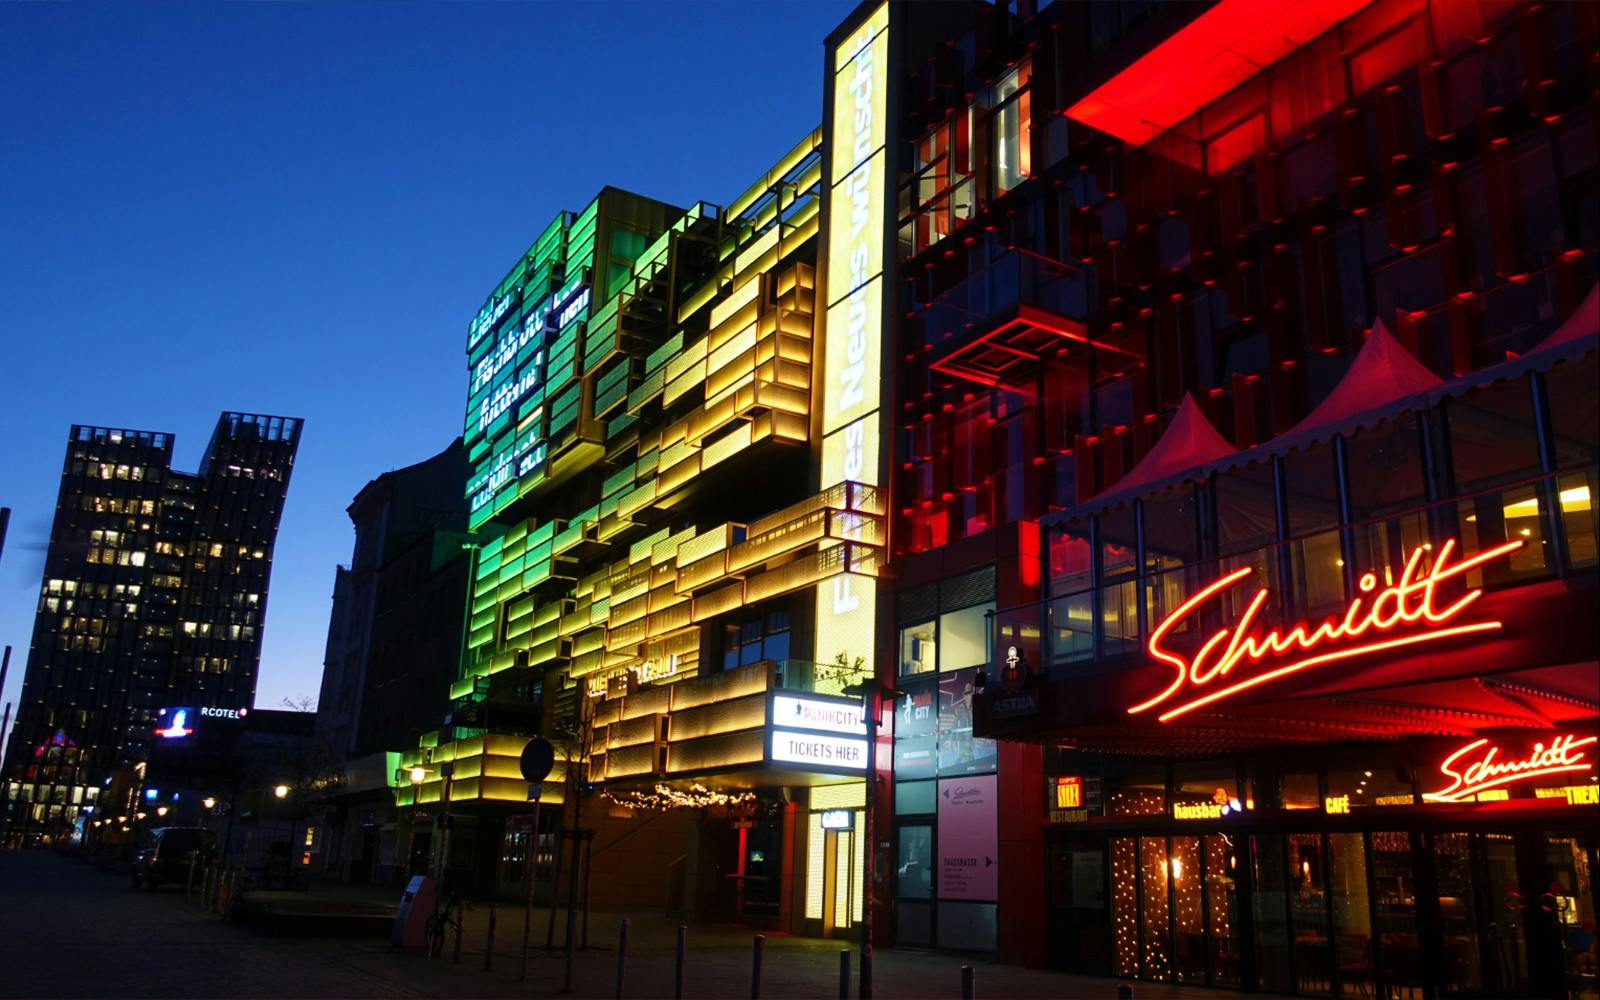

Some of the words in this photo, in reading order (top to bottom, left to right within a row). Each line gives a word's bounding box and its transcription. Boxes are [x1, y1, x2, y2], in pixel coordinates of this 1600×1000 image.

[847, 25, 874, 237] wünscht
[839, 243, 868, 411] Neues
[1127, 539, 1526, 716] Schmidt
[915, 706, 930, 719] CITY
[789, 741, 832, 758] TICKETS
[835, 746, 859, 760] HIER
[1422, 735, 1598, 799] Schmidt
[1173, 802, 1221, 819] hausbar
[1325, 794, 1350, 814] CAFÉ
